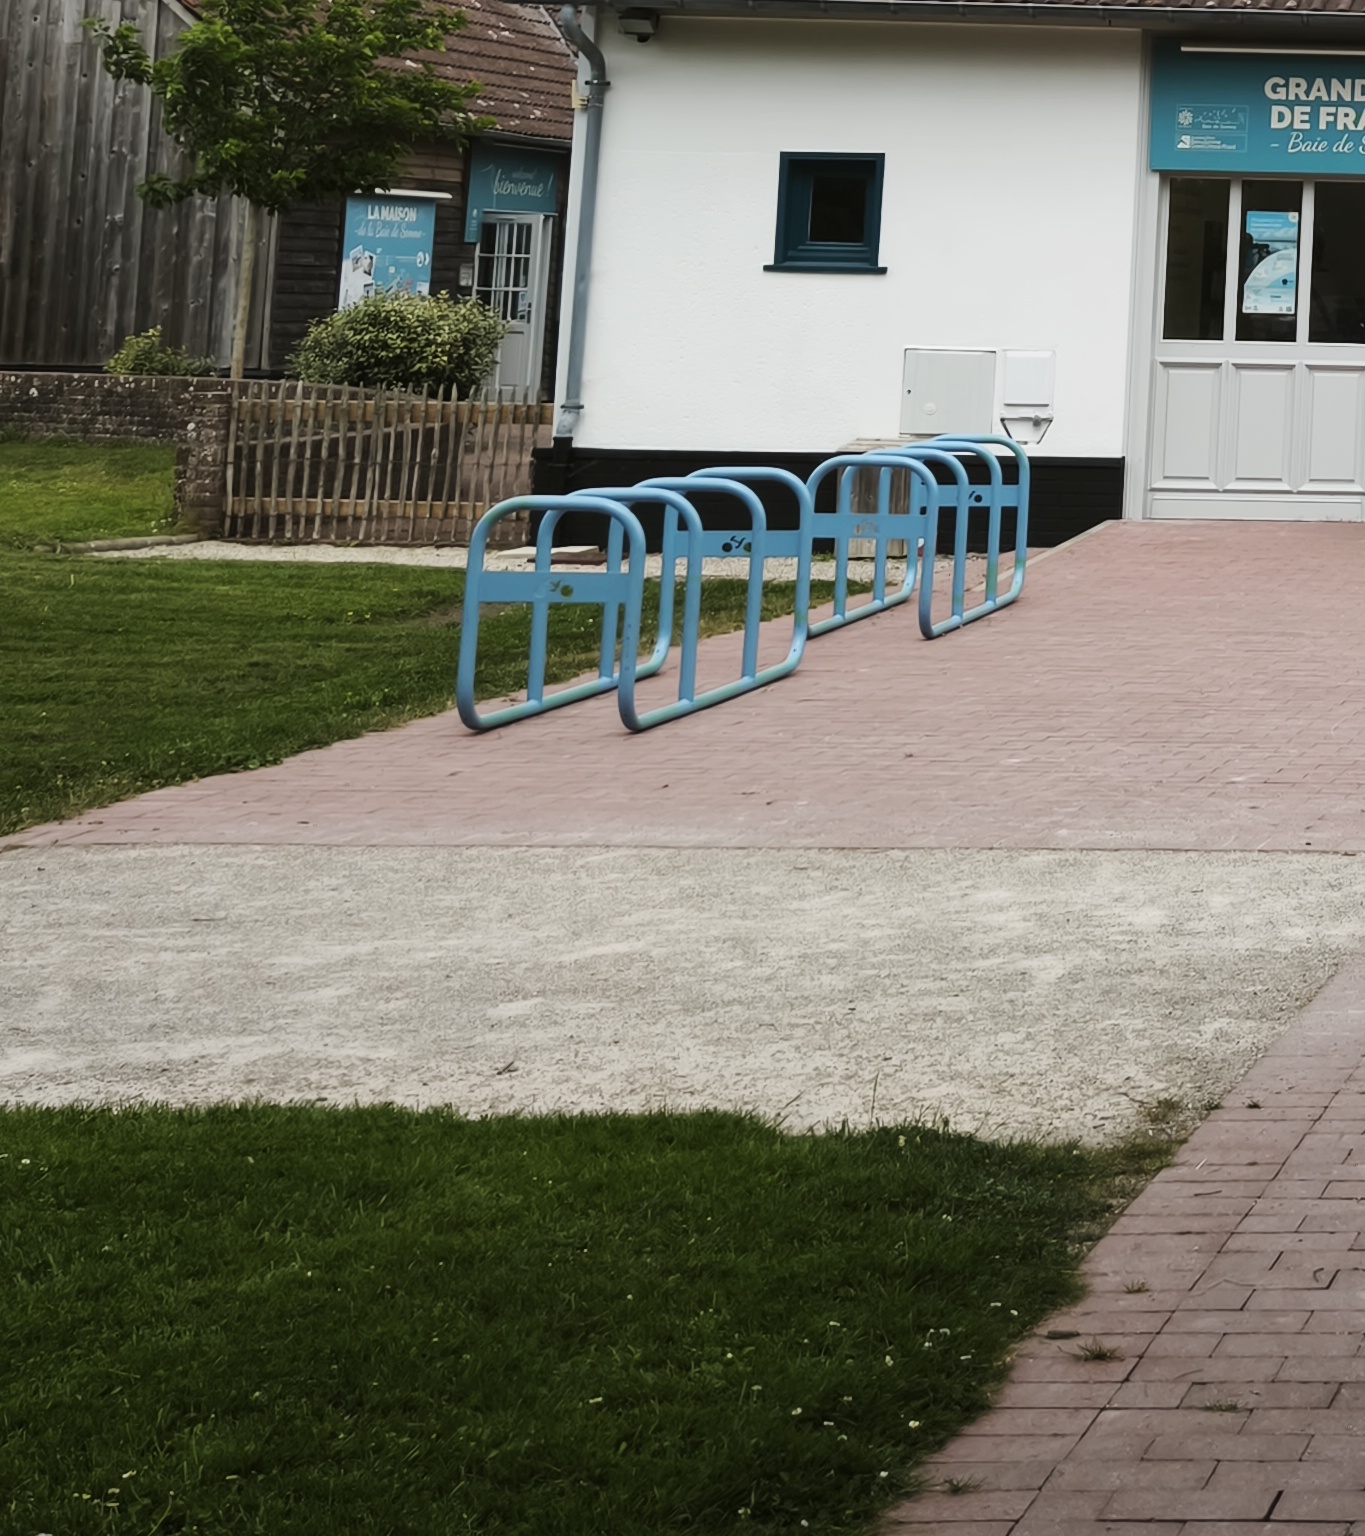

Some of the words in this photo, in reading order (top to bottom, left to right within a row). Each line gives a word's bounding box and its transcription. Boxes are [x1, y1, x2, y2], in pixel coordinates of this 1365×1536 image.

[1270, 105, 1311, 130] DE
[1288, 131, 1329, 153] Baie
[1333, 133, 1354, 153] de
[367, 205, 380, 220] LA
[381, 205, 417, 221] MAISON
